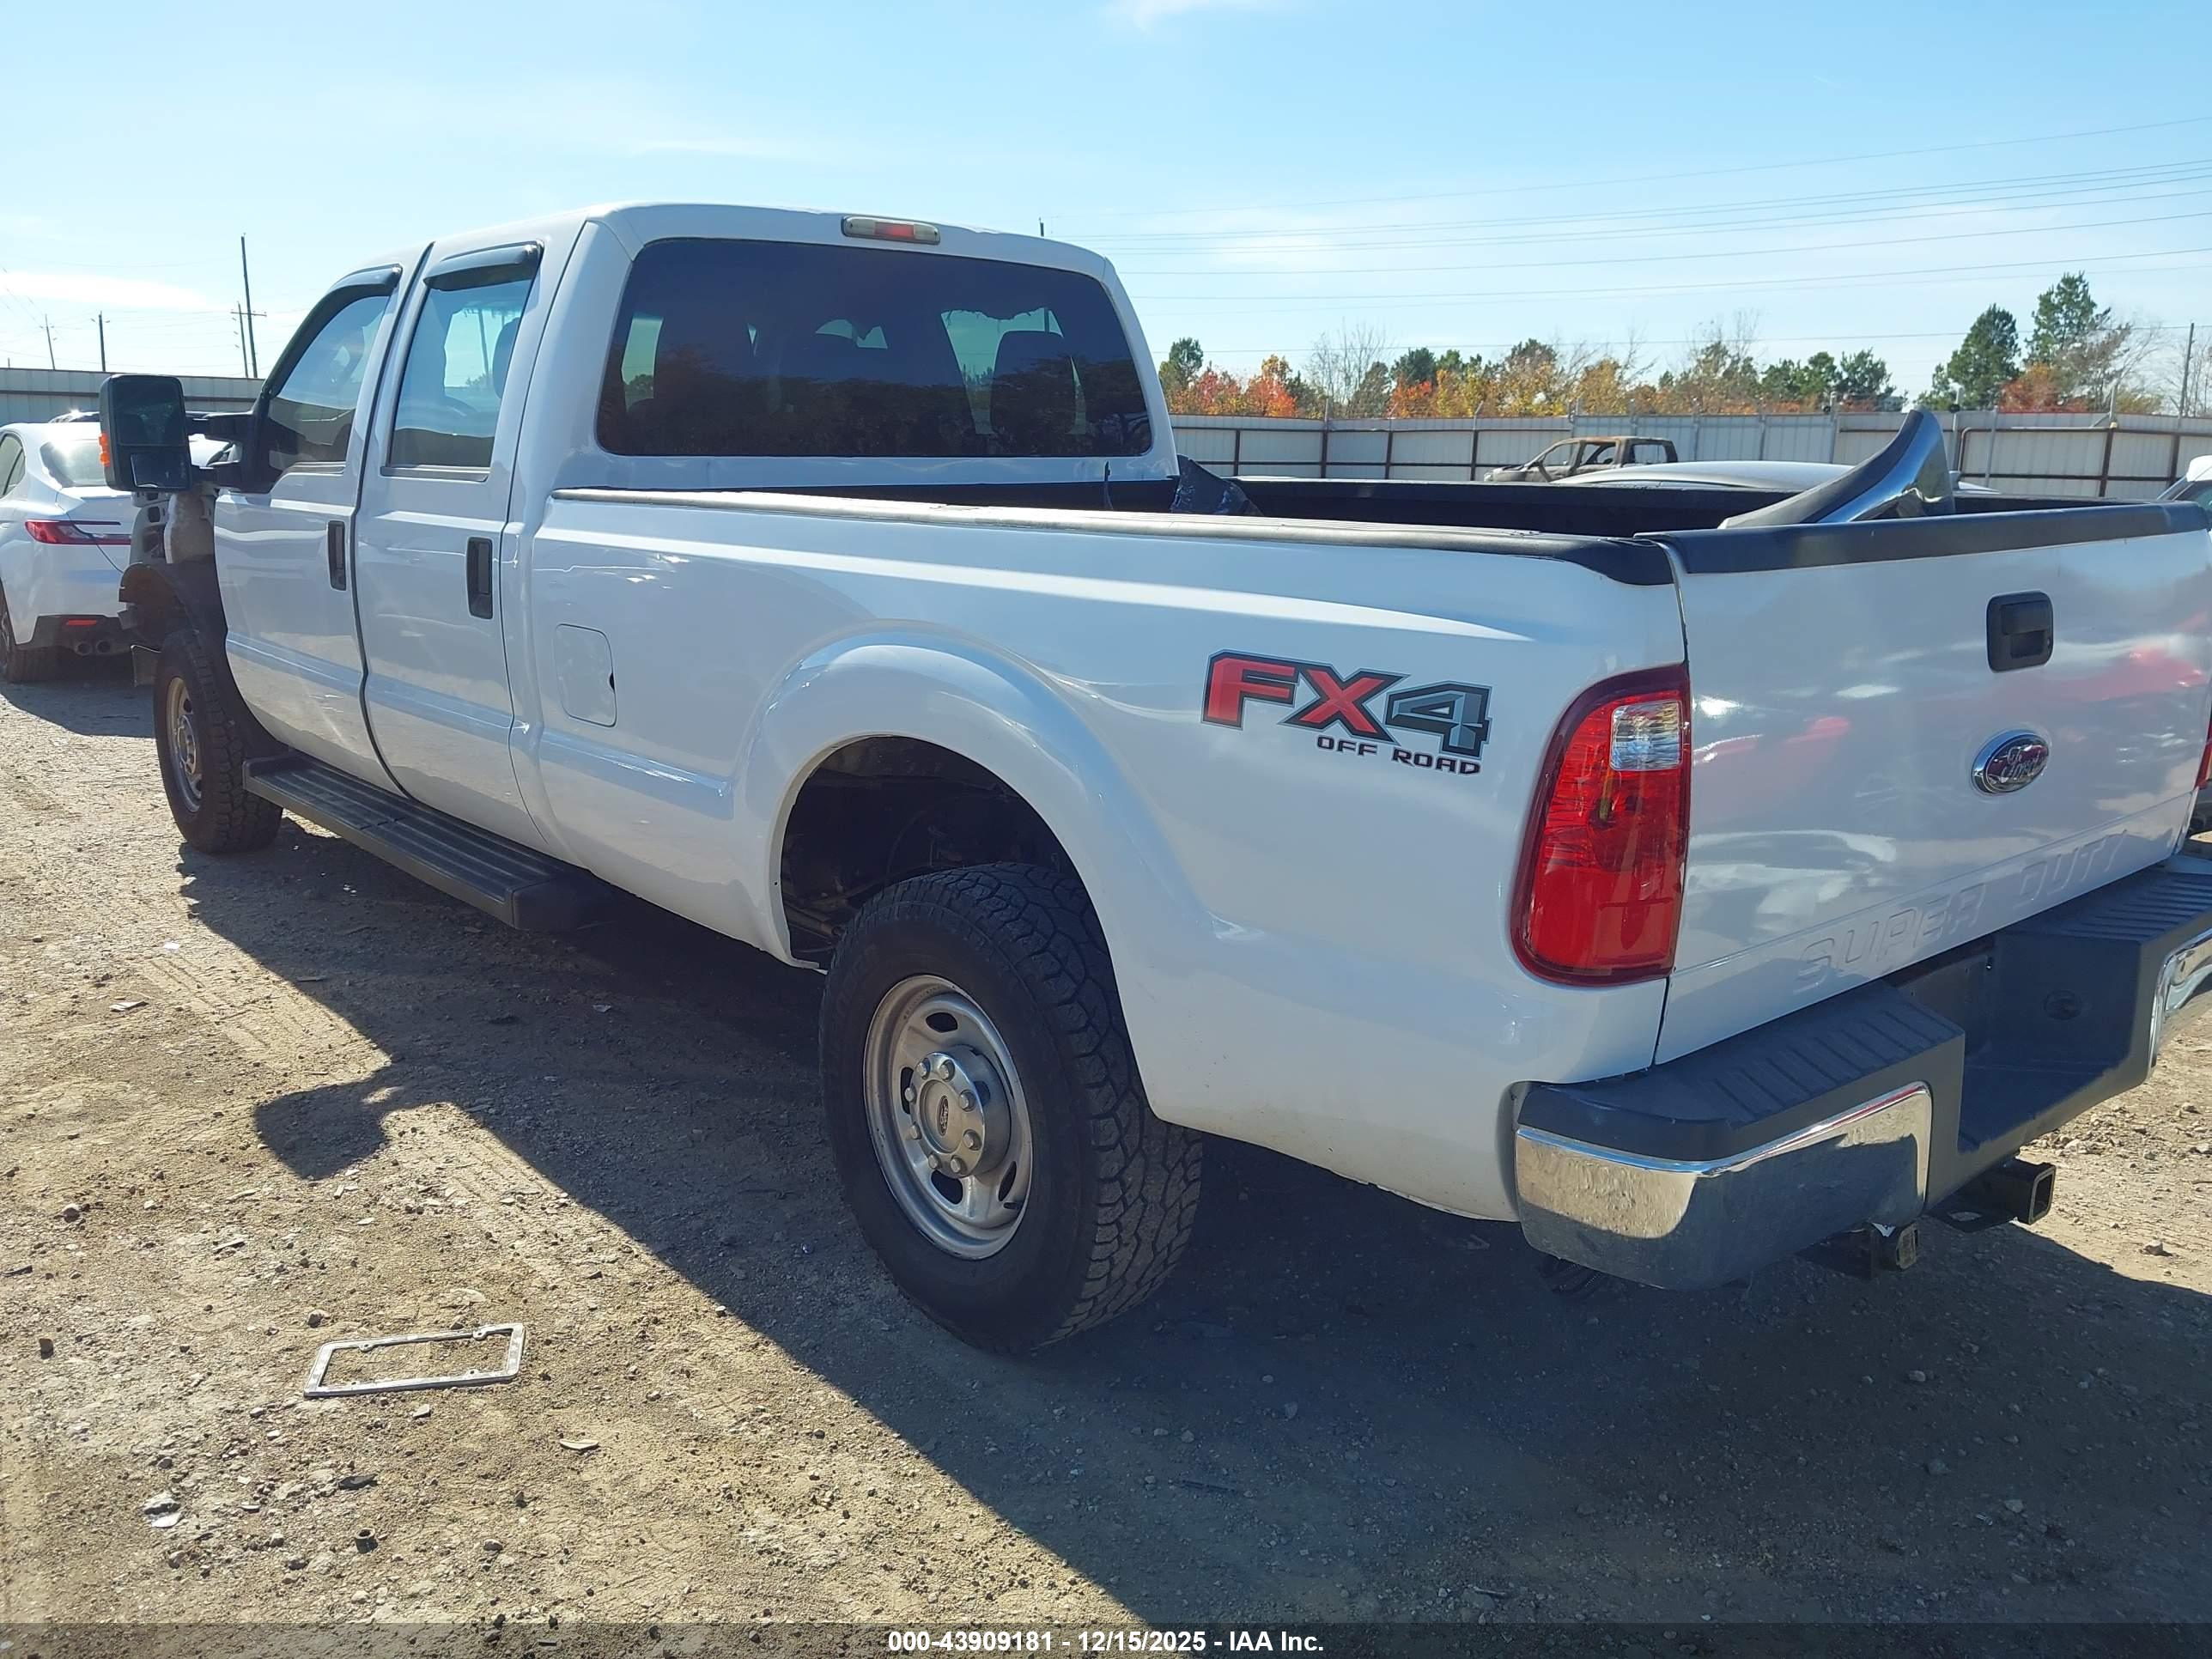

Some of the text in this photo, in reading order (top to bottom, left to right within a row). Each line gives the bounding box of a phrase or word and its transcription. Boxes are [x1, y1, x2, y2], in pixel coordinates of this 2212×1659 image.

[1201, 649, 1492, 760] FX4
[1316, 735, 1480, 775] OFF ROAD
[1793, 883, 1987, 994] SUPER
